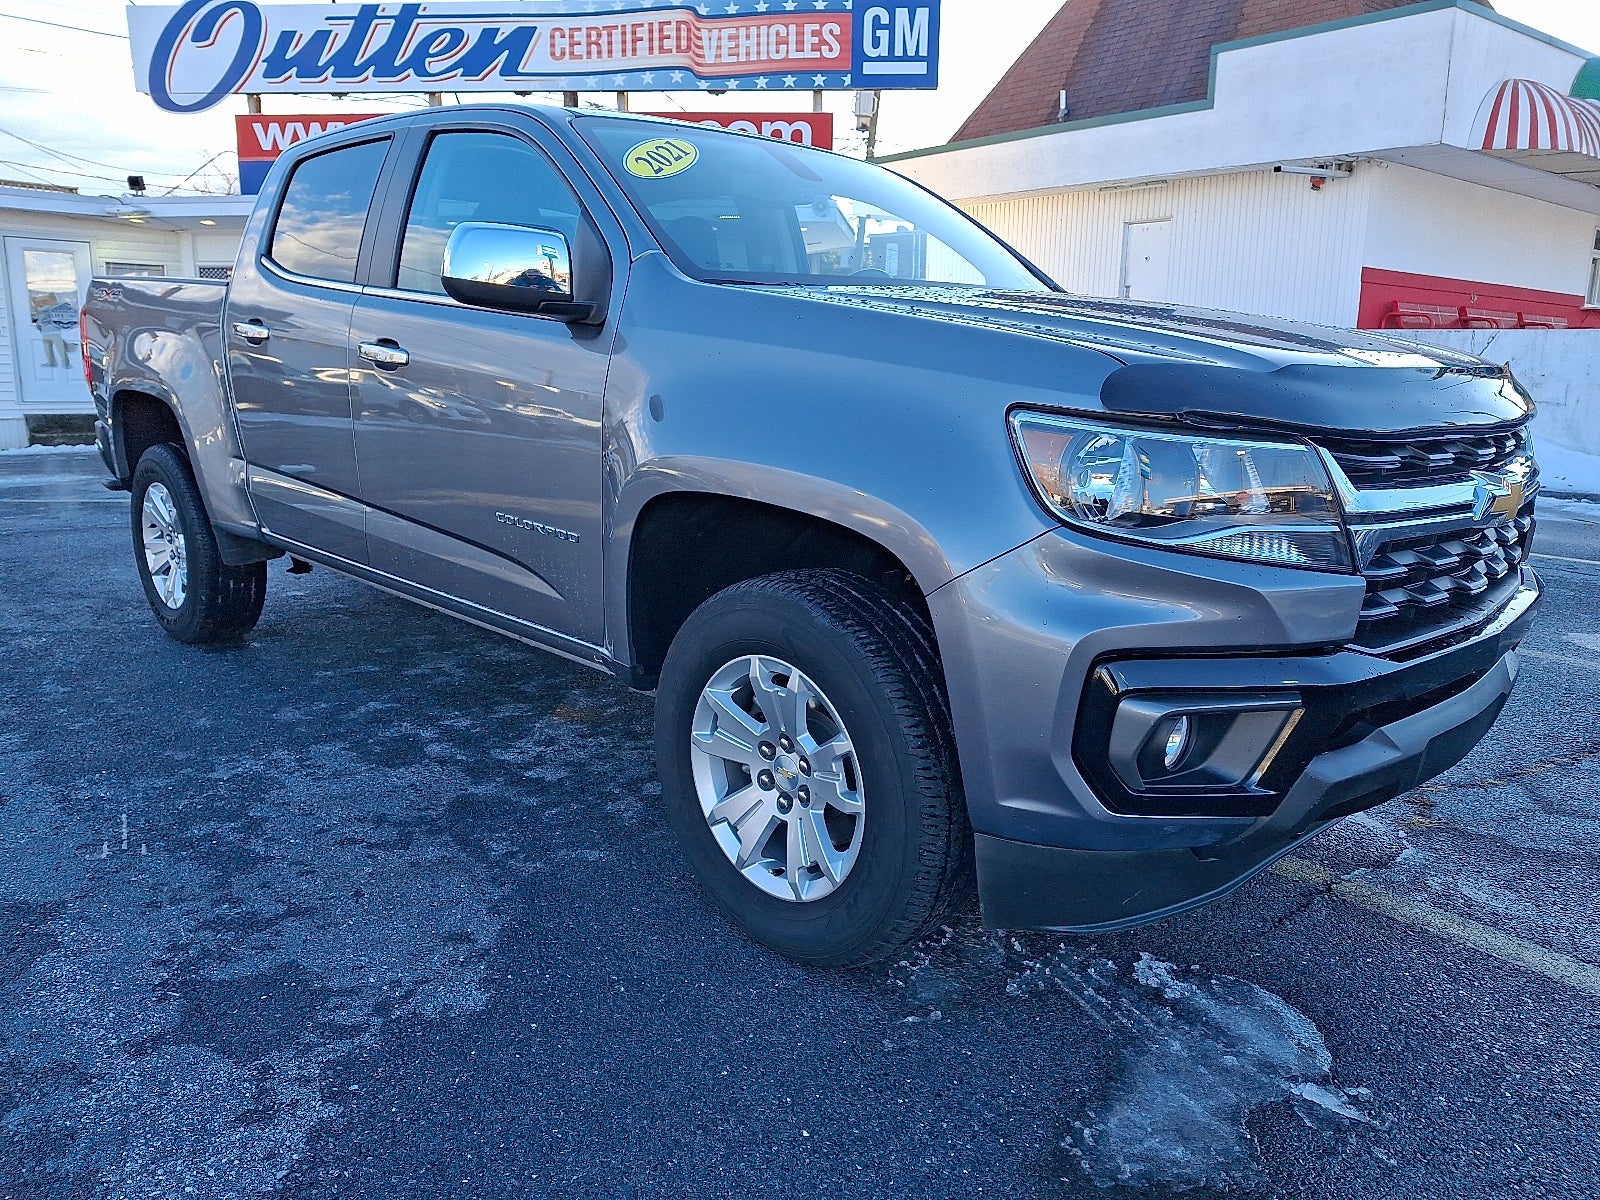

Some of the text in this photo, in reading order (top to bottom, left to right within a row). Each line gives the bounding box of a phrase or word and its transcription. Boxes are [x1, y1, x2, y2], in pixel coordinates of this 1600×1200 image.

[549, 20, 841, 64] CERTIFIED VEHICLES
[862, 7, 929, 58] GM
[149, 0, 538, 113] Outten
[634, 140, 691, 175] 2021
[495, 511, 580, 543] COLORADO
